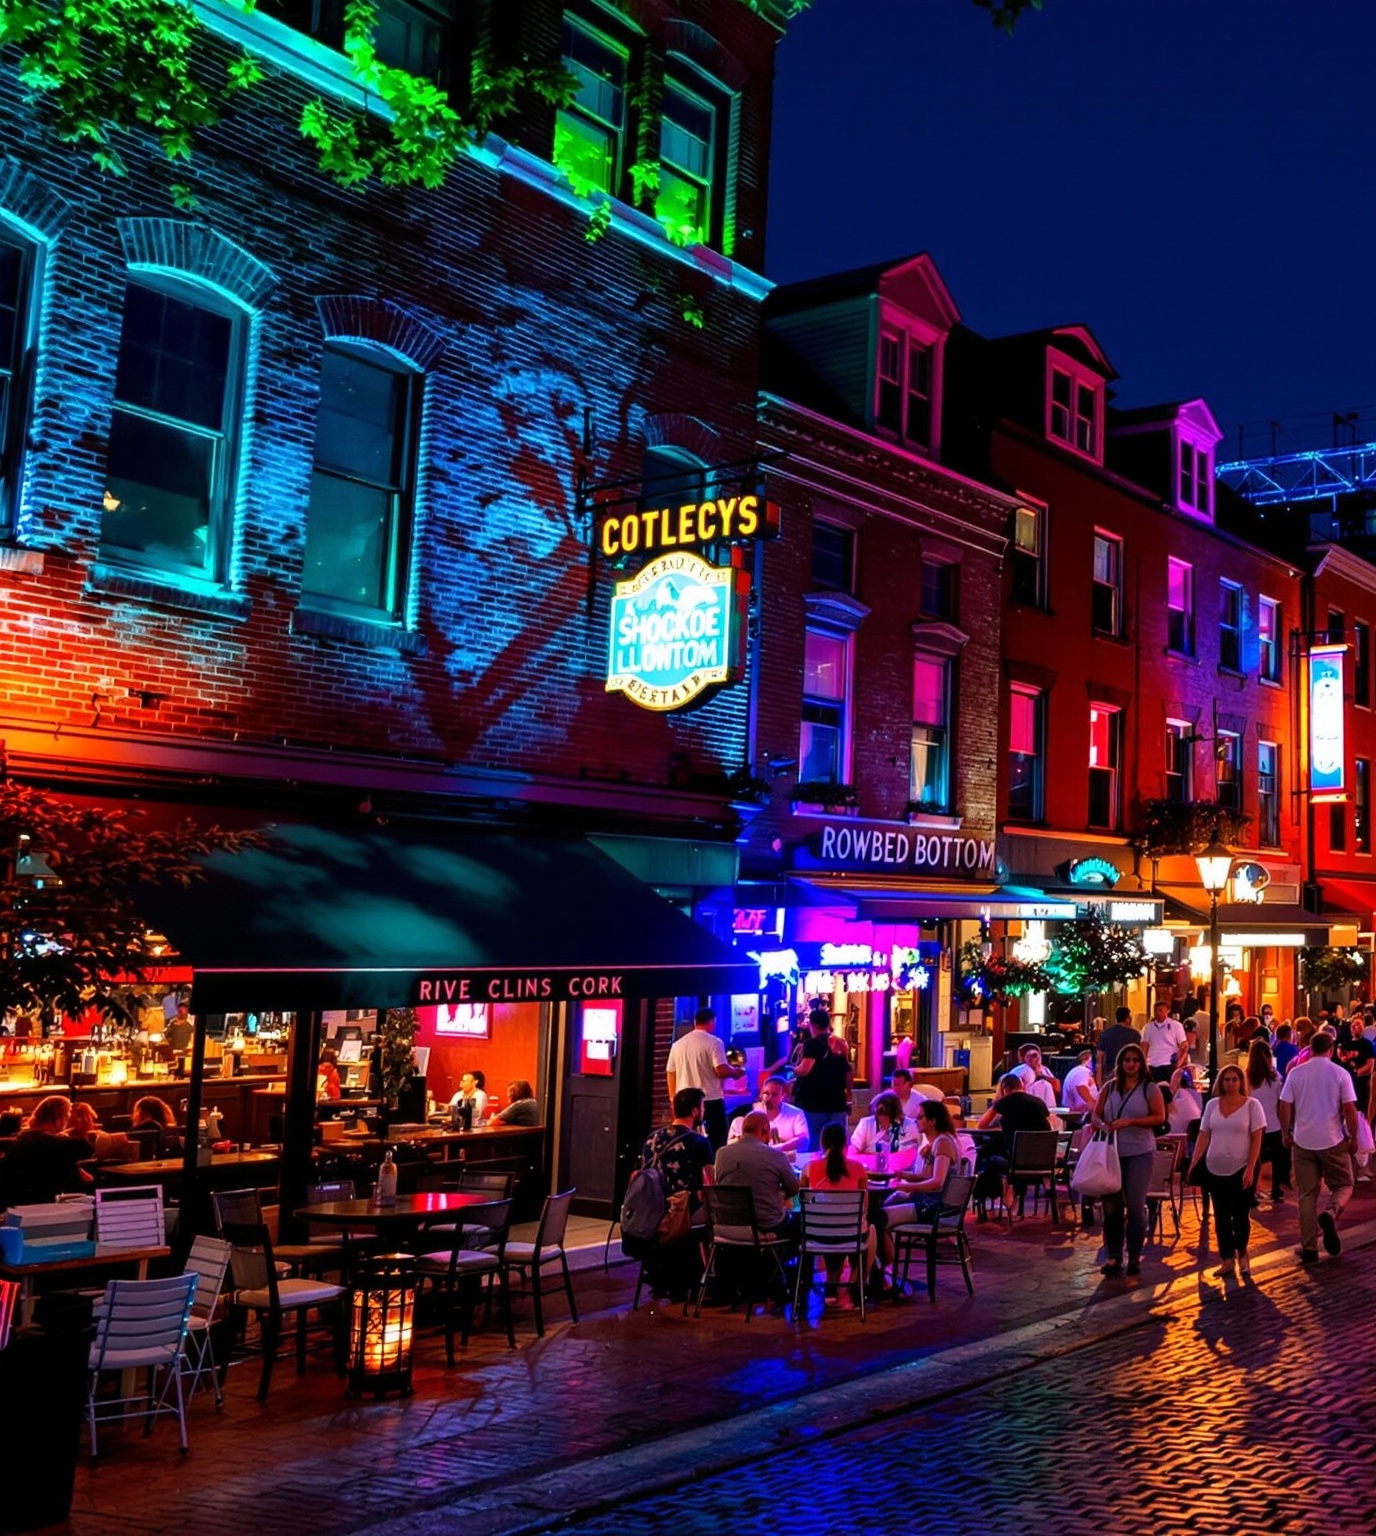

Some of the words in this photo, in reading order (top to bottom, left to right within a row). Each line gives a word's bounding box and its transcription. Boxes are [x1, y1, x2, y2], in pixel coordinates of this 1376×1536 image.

[603, 496, 759, 556] COTLECYS
[822, 826, 909, 864] ROWBED
[915, 834, 995, 870] BOTTOM
[420, 979, 471, 1000] RIVE
[488, 978, 551, 998] CLINS
[569, 976, 622, 996] CORK
